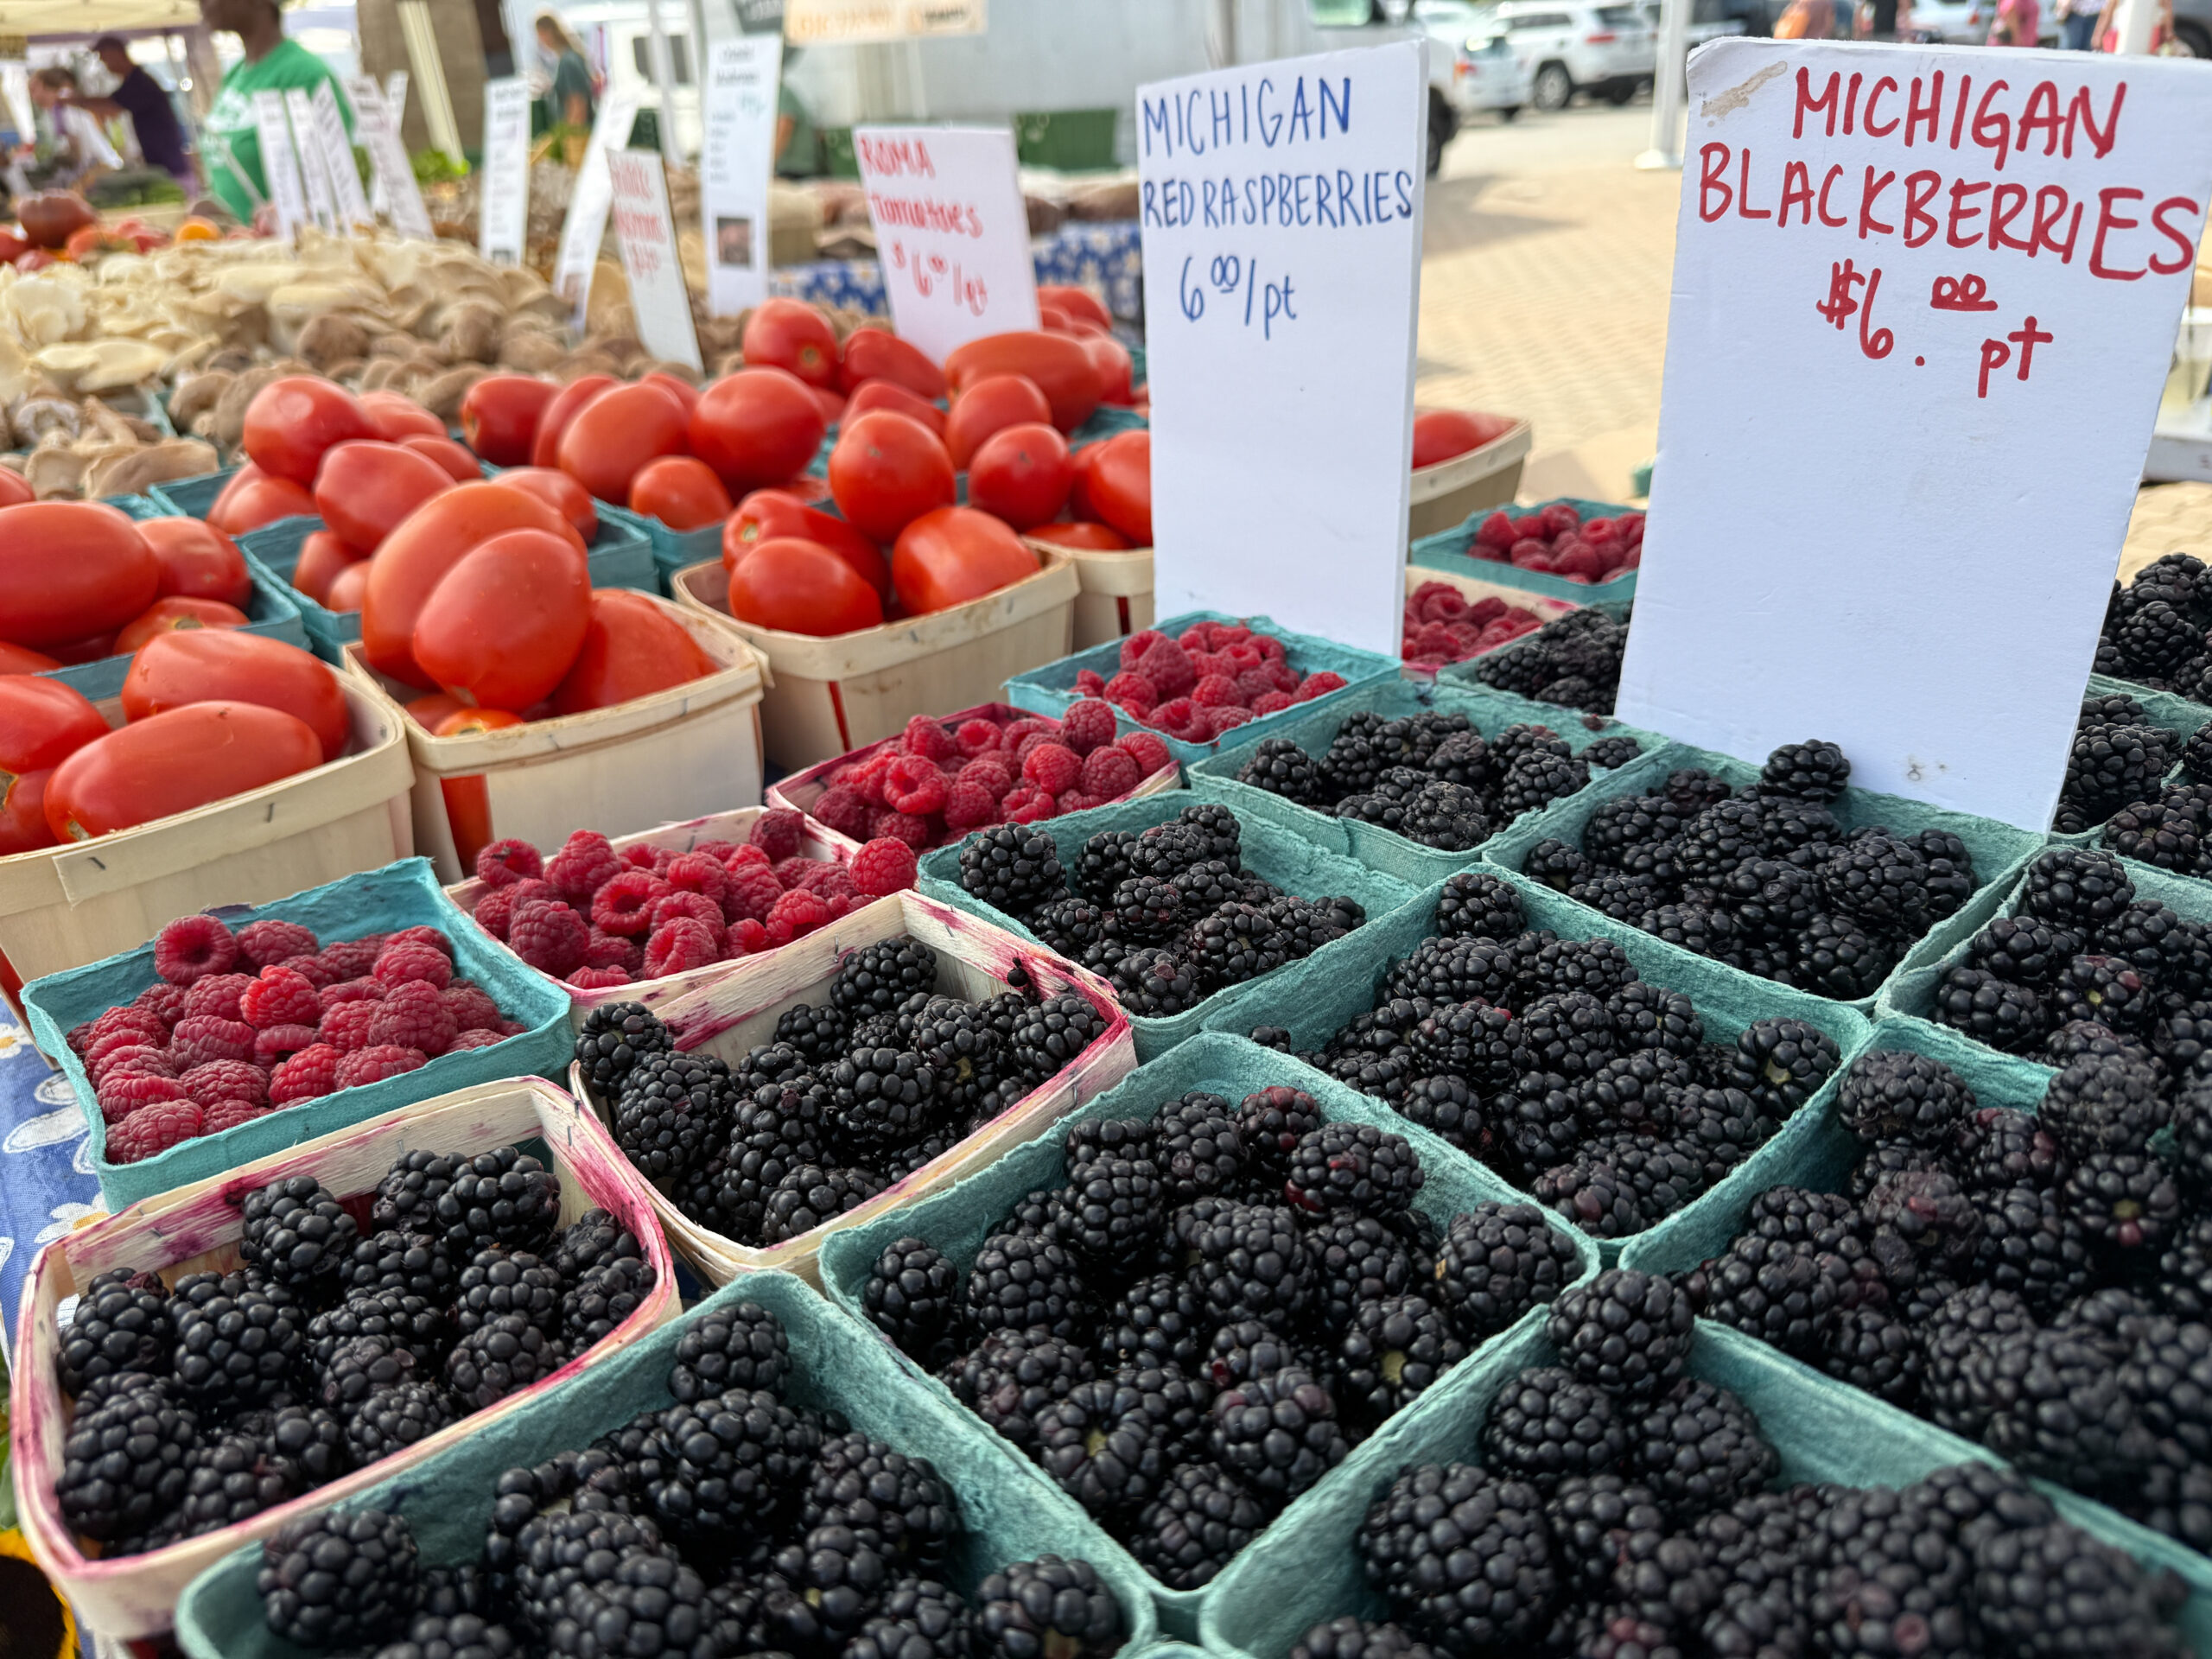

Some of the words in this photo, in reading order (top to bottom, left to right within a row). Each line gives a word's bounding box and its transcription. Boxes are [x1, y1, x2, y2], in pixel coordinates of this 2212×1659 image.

[1142, 75, 1351, 158] MICHIGAN
[1791, 67, 2128, 172] MICHIGAN
[861, 137, 937, 180] ROMA
[1142, 178, 1195, 229] RED
[1202, 168, 1414, 230] RASPBERRIES
[1698, 142, 2202, 282] BLACKBERRIES
[1976, 315, 2055, 399] pt
